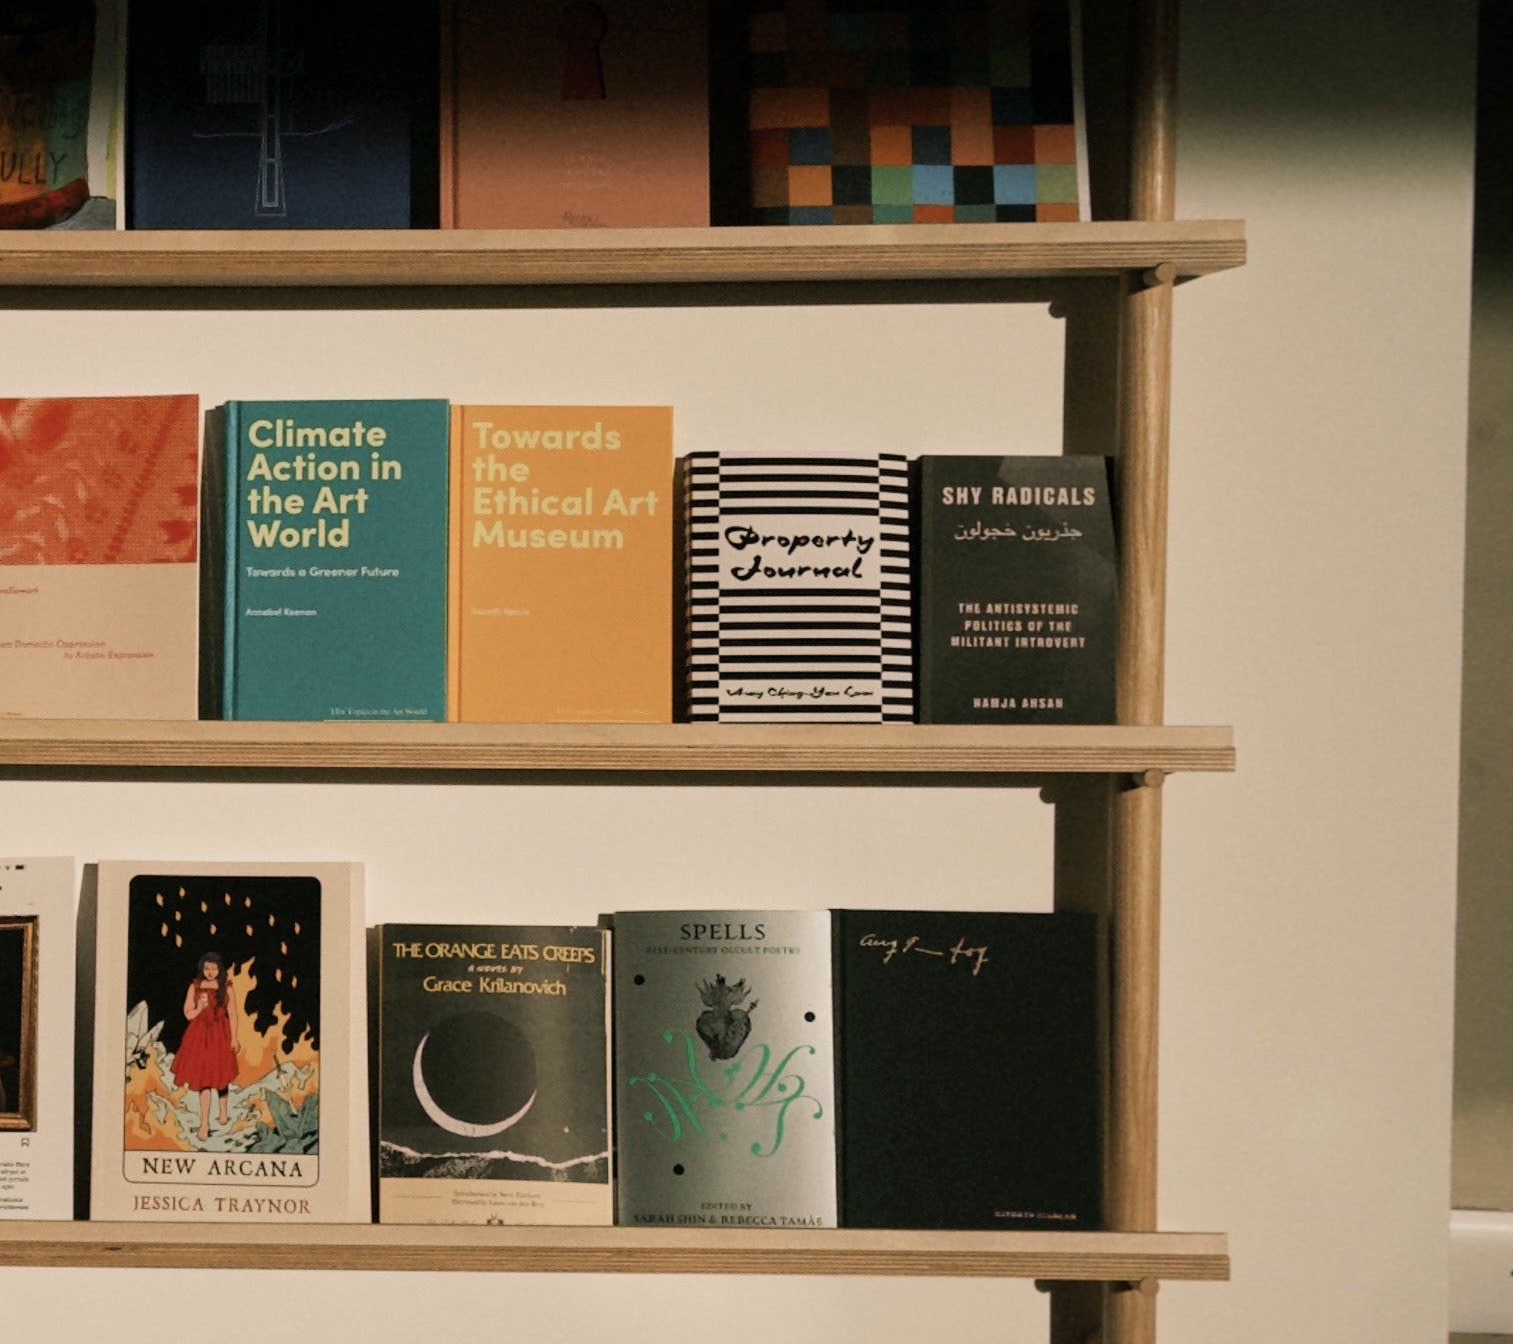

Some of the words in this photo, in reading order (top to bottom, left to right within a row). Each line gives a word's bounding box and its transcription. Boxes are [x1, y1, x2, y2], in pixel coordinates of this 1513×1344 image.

[248, 419, 387, 448] Climate
[472, 421, 621, 450] Towards
[247, 453, 360, 481] Action
[371, 452, 402, 480] in
[472, 456, 529, 482] the
[247, 485, 304, 514] the
[312, 486, 368, 514] Art
[473, 487, 592, 515] Ethical
[602, 489, 658, 516] Art
[942, 487, 982, 505] SHY
[991, 487, 1096, 506] RADICALS
[246, 518, 350, 548] World
[472, 520, 624, 549] Museum
[724, 525, 875, 555] Property
[246, 566, 296, 577] Towards
[309, 566, 358, 577] Greener
[360, 566, 399, 577] Future
[730, 555, 862, 581] Journal
[958, 602, 981, 614] THE
[985, 603, 1079, 615] ANTISYSTEMIC
[964, 620, 1022, 631] POLITICS
[1027, 620, 1044, 632] OF
[1048, 621, 1072, 632] THE
[951, 636, 1010, 647] MILITANT
[1015, 637, 1085, 648] INTROVERT
[680, 924, 766, 940] SPELLS
[393, 942, 423, 958] THE
[424, 942, 496, 959] ORANGE
[501, 944, 538, 960] EATS
[543, 945, 596, 964] CREEPS
[423, 976, 472, 993] Grace
[479, 977, 566, 995] Krilanovich
[143, 1158, 195, 1174] NEW
[207, 1159, 303, 1177] ARCANA
[132, 1195, 204, 1211] JESSICA
[214, 1197, 311, 1214] TRAYNOR
